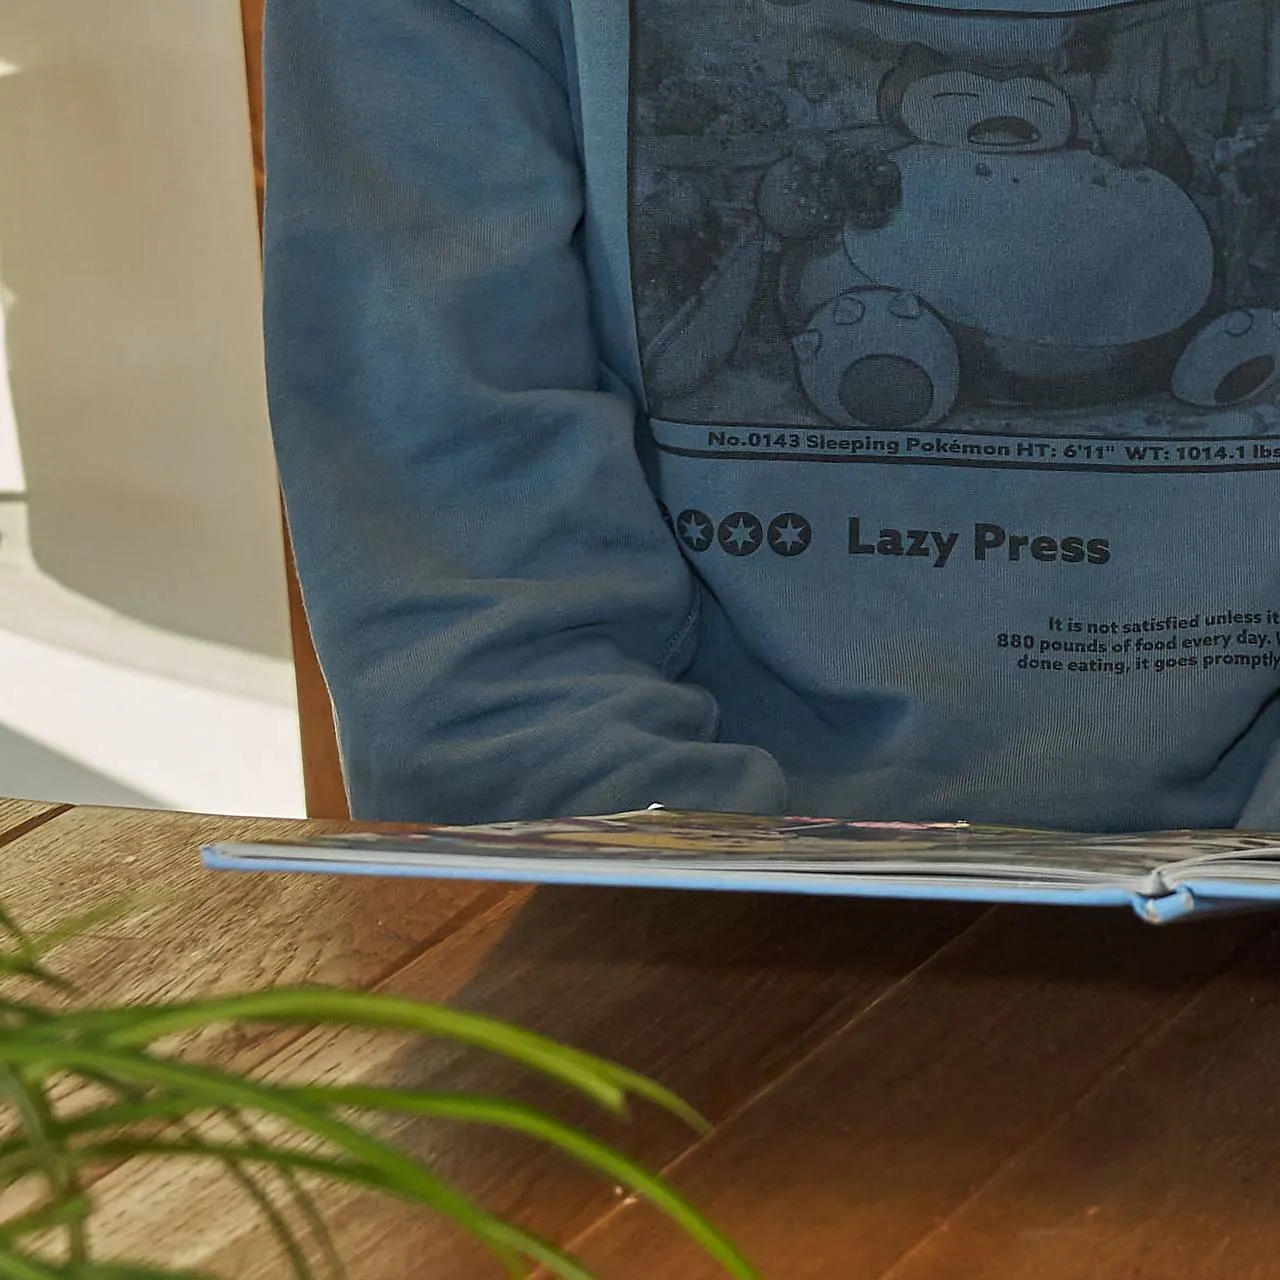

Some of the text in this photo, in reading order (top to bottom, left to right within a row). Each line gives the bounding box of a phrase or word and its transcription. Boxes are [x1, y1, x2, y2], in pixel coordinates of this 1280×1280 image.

[708, 431, 800, 449] No.0143
[806, 434, 900, 455] Sleeping
[906, 436, 1009, 457] Pokémon
[1016, 442, 1057, 458] HT:
[1063, 443, 1115, 459] 6'11"
[1124, 445, 1170, 461] WT:
[1176, 445, 1246, 461] 1014.1
[848, 517, 960, 568] Lazy
[974, 523, 1112, 565] Press
[1048, 616, 1062, 631] It
[1068, 618, 1082, 632] is
[1087, 620, 1118, 634] not
[1122, 614, 1200, 634] satisfied
[1205, 609, 1262, 626] unless
[1267, 609, 1280, 625] it
[997, 633, 1034, 649] 880
[1040, 638, 1107, 654] pounds
[1111, 638, 1132, 654] of
[1136, 635, 1177, 652] food
[1182, 633, 1231, 649] every
[1236, 628, 1271, 649] day.
[1017, 654, 1063, 671] done
[1067, 657, 1130, 675] eating,
[1136, 657, 1149, 670] it
[1153, 656, 1198, 672] goes
[1203, 650, 1280, 670] promptly
